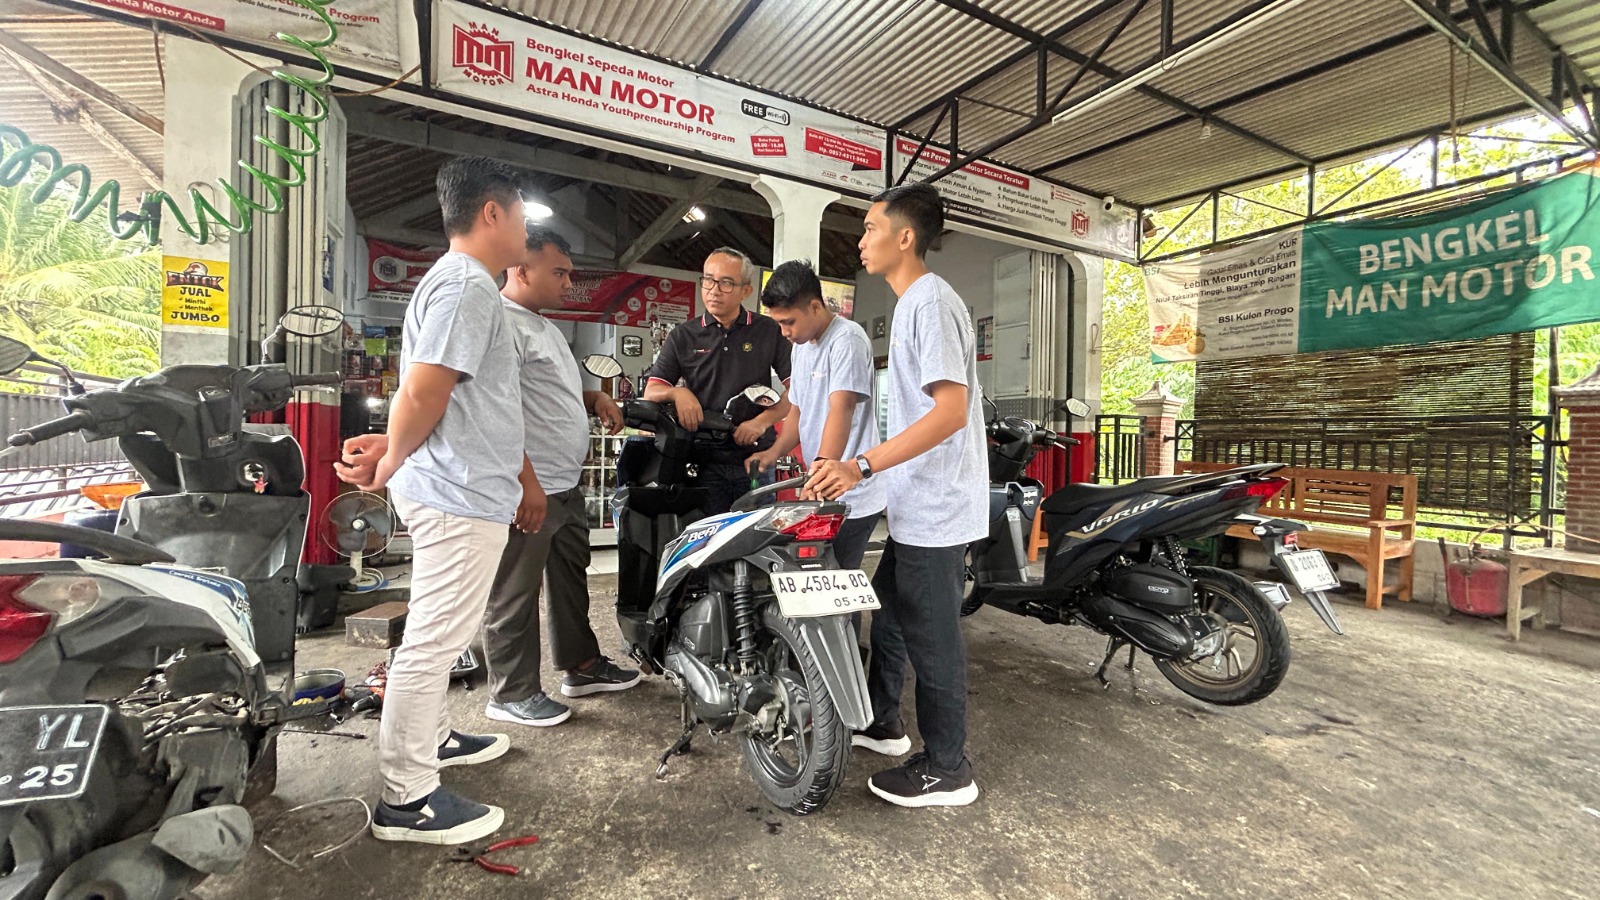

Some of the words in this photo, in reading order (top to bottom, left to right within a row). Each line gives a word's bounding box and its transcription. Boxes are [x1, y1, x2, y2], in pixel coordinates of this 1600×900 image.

[142, 2, 180, 17] Motor
[183, 12, 216, 26] Anda
[329, 7, 380, 23] Program
[469, 22, 499, 36] MAN
[526, 38, 584, 63] Bengkel
[587, 55, 634, 77] Sepeda
[637, 70, 674, 87] Motor
[463, 69, 504, 86] MOTOR
[526, 57, 602, 96] MAN
[610, 80, 715, 125] MOTOR
[526, 84, 559, 98] Astra
[562, 92, 599, 108] Honda
[601, 102, 694, 133] Youthpreneurship
[696, 126, 736, 143] Program
[743, 103, 763, 116] FREE
[902, 143, 930, 158] Manat
[984, 168, 1003, 179] Secara
[1003, 174, 1025, 186] Teratur
[1278, 238, 1297, 250] KUR
[1358, 208, 1549, 275] BENGKEL
[1276, 250, 1296, 261] Emas
[1184, 278, 1210, 290] Lebih
[1211, 260, 1296, 284] Menguntungkan
[1200, 286, 1225, 298] Tinggi,
[1226, 282, 1248, 293] Biaya
[1267, 271, 1296, 283] Ringan
[1325, 278, 1408, 318] MAN
[1421, 245, 1595, 308] MOTOR
[180, 286, 211, 298] JUAL
[171, 311, 220, 322] JUMBO
[1236, 312, 1262, 321] Kulon
[1264, 306, 1294, 317] Progo
[1082, 498, 1159, 533] VARIO
[778, 576, 797, 593] AB
[804, 574, 840, 592] 4584
[36, 713, 90, 750] YL
